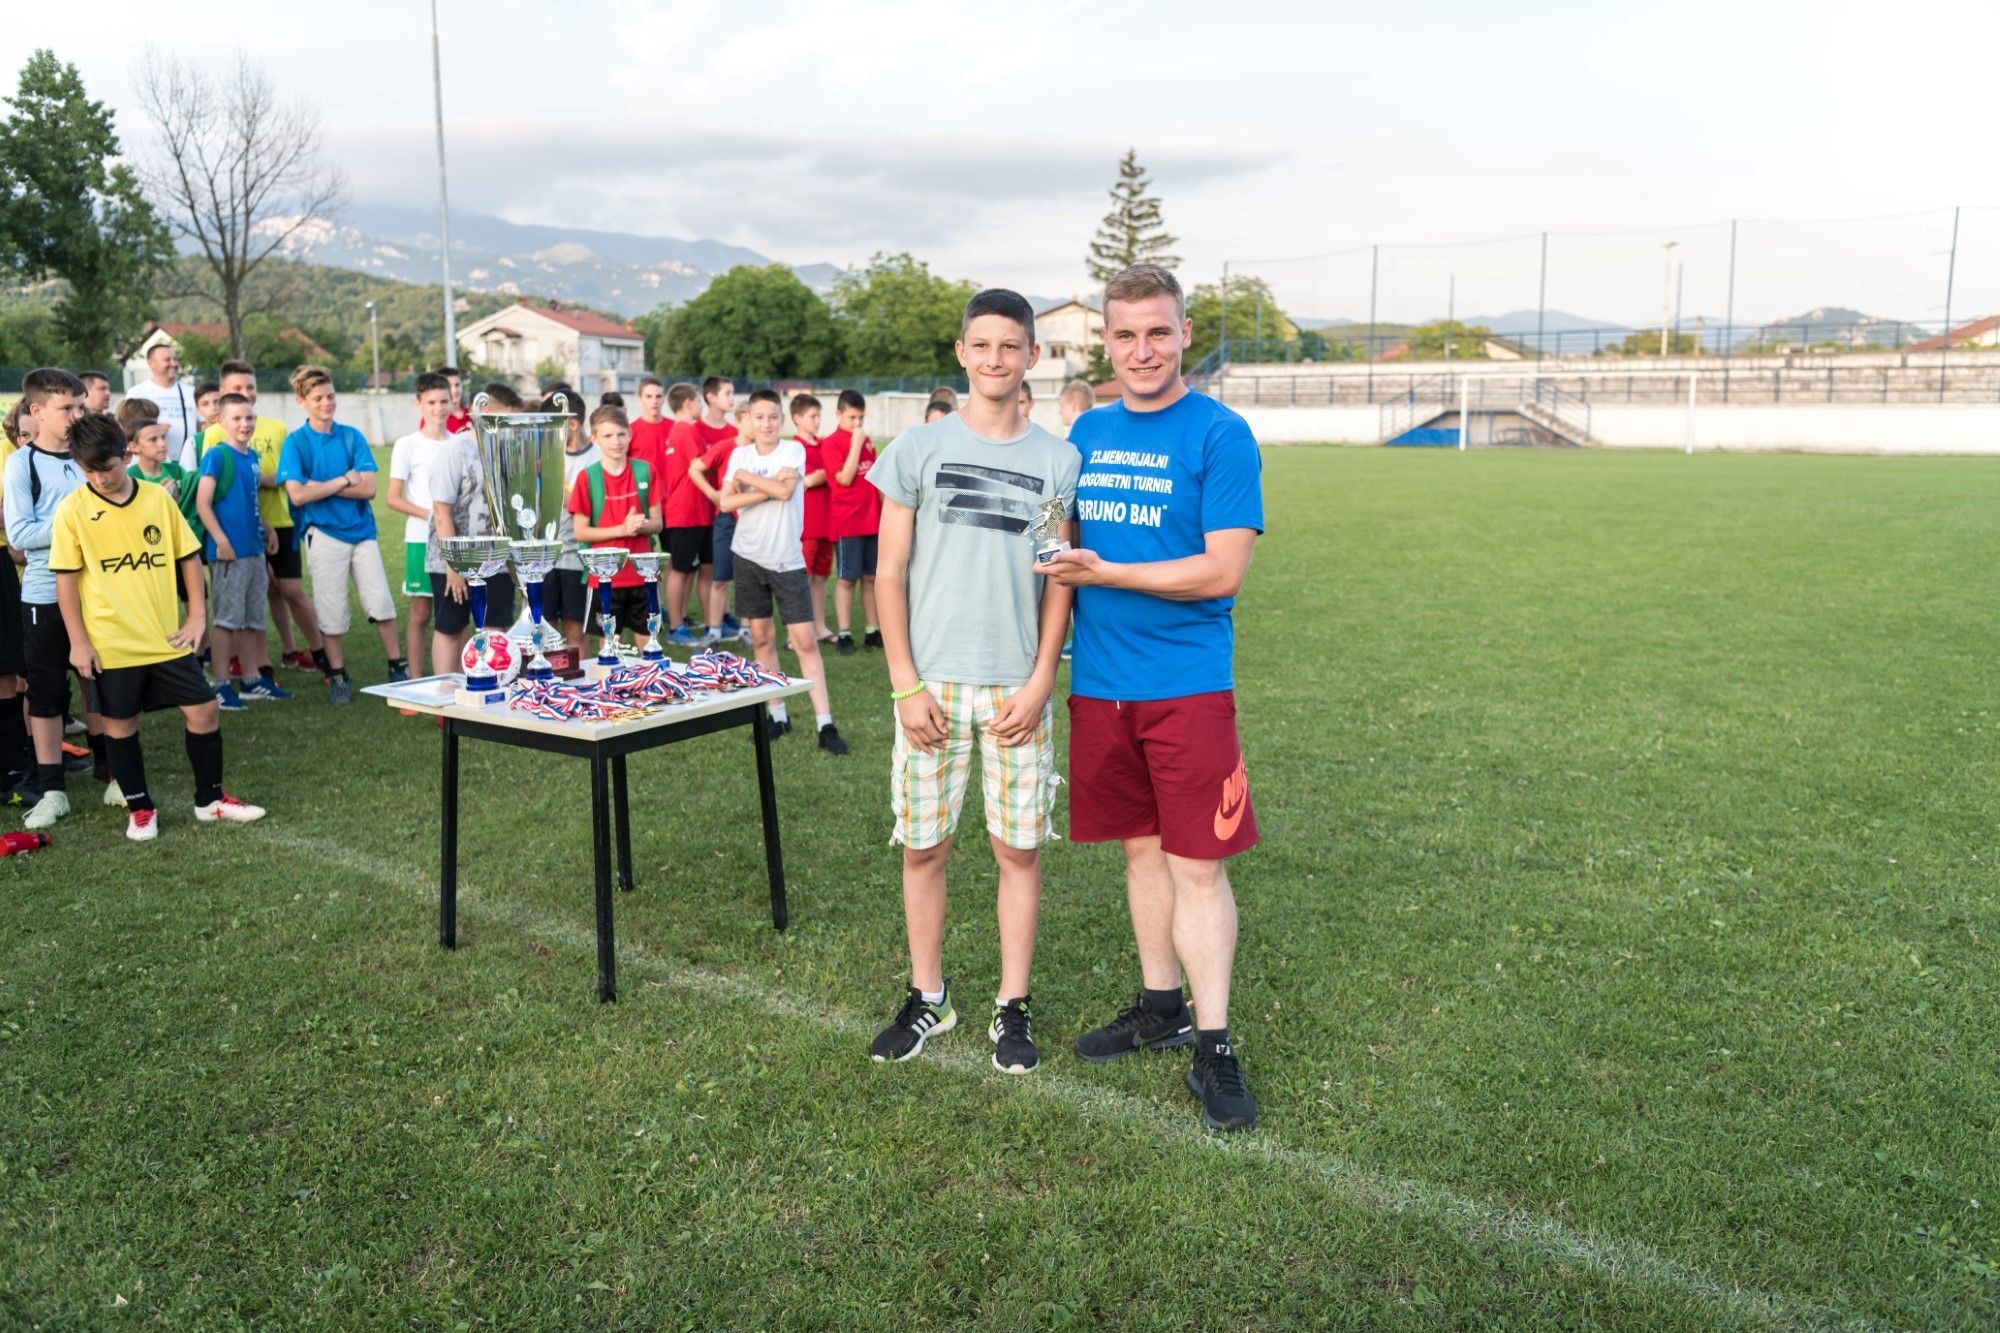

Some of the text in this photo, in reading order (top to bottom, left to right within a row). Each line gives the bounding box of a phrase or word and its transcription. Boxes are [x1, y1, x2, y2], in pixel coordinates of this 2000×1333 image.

[1133, 475, 1172, 494] TURNIR
[100, 551, 166, 573] FAAC
[31, 606, 37, 625] 1
[1223, 755, 1247, 814] NIK
